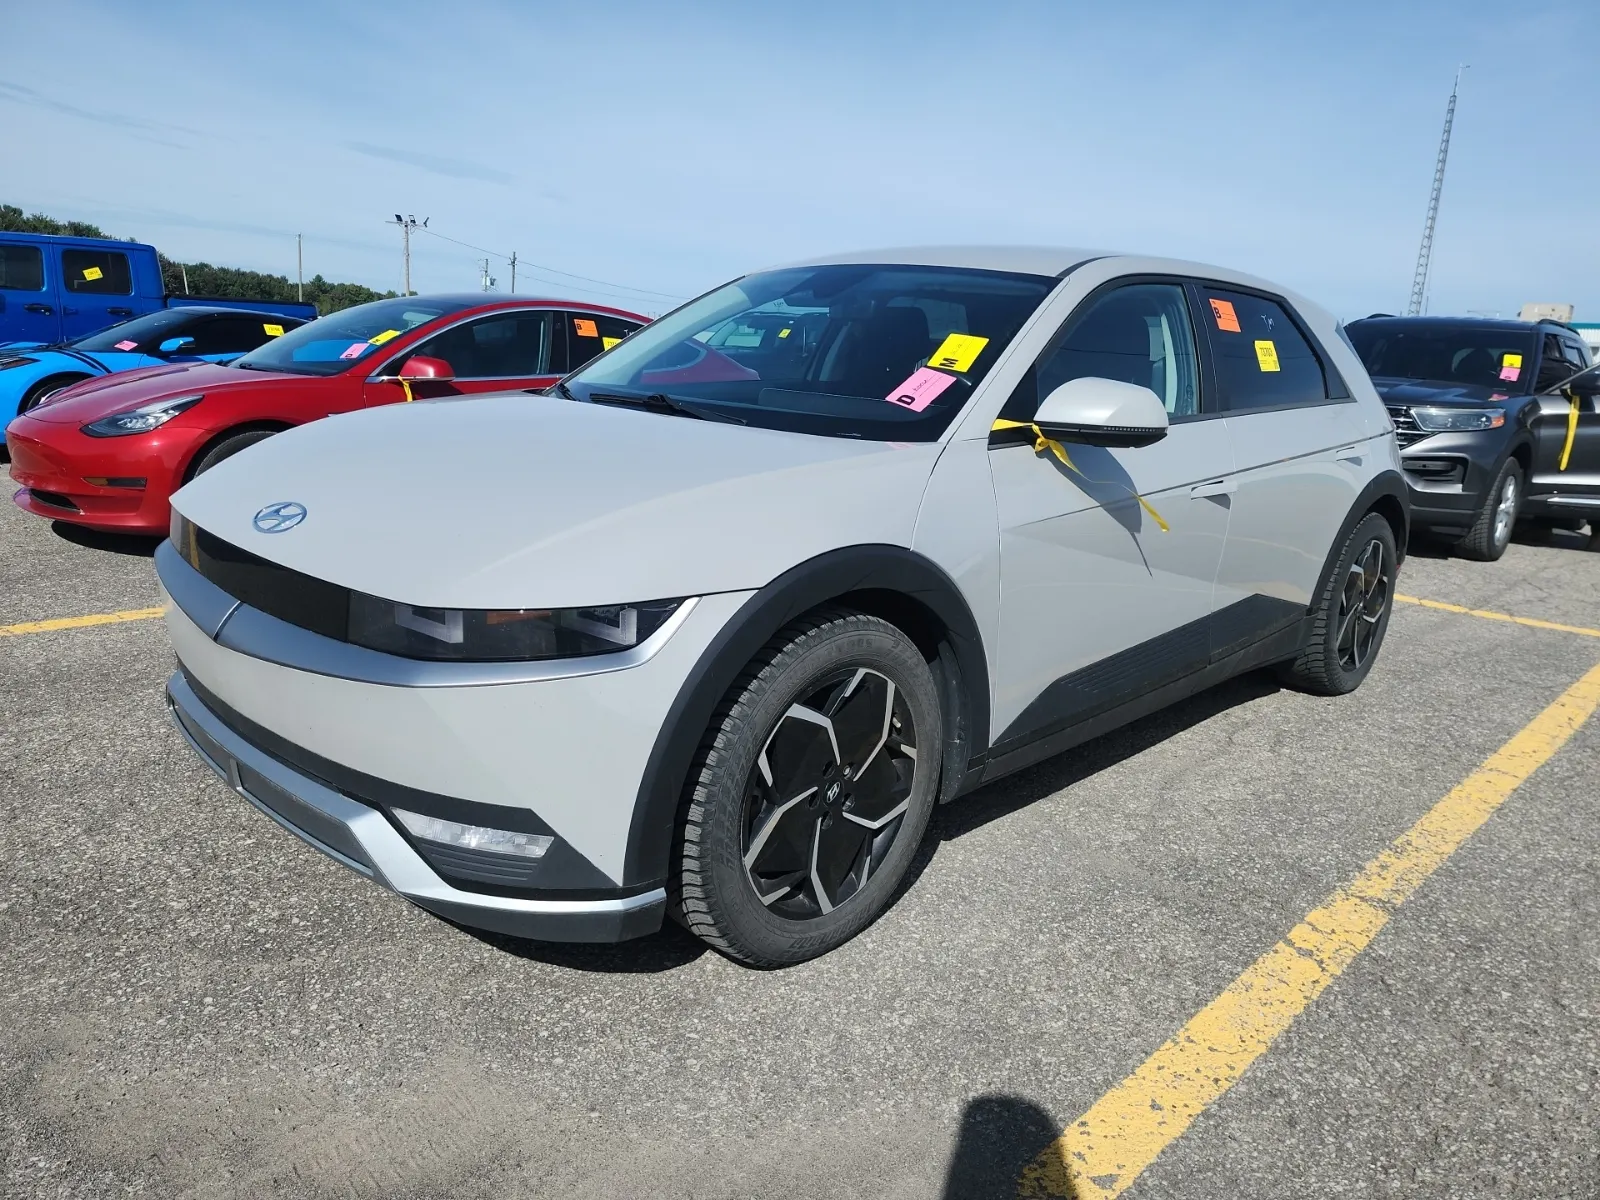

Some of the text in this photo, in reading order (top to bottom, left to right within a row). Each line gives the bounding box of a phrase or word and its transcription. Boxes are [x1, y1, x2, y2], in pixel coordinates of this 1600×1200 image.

[1214, 307, 1222, 319] B
[939, 358, 959, 368] M
[895, 394, 916, 406] D
